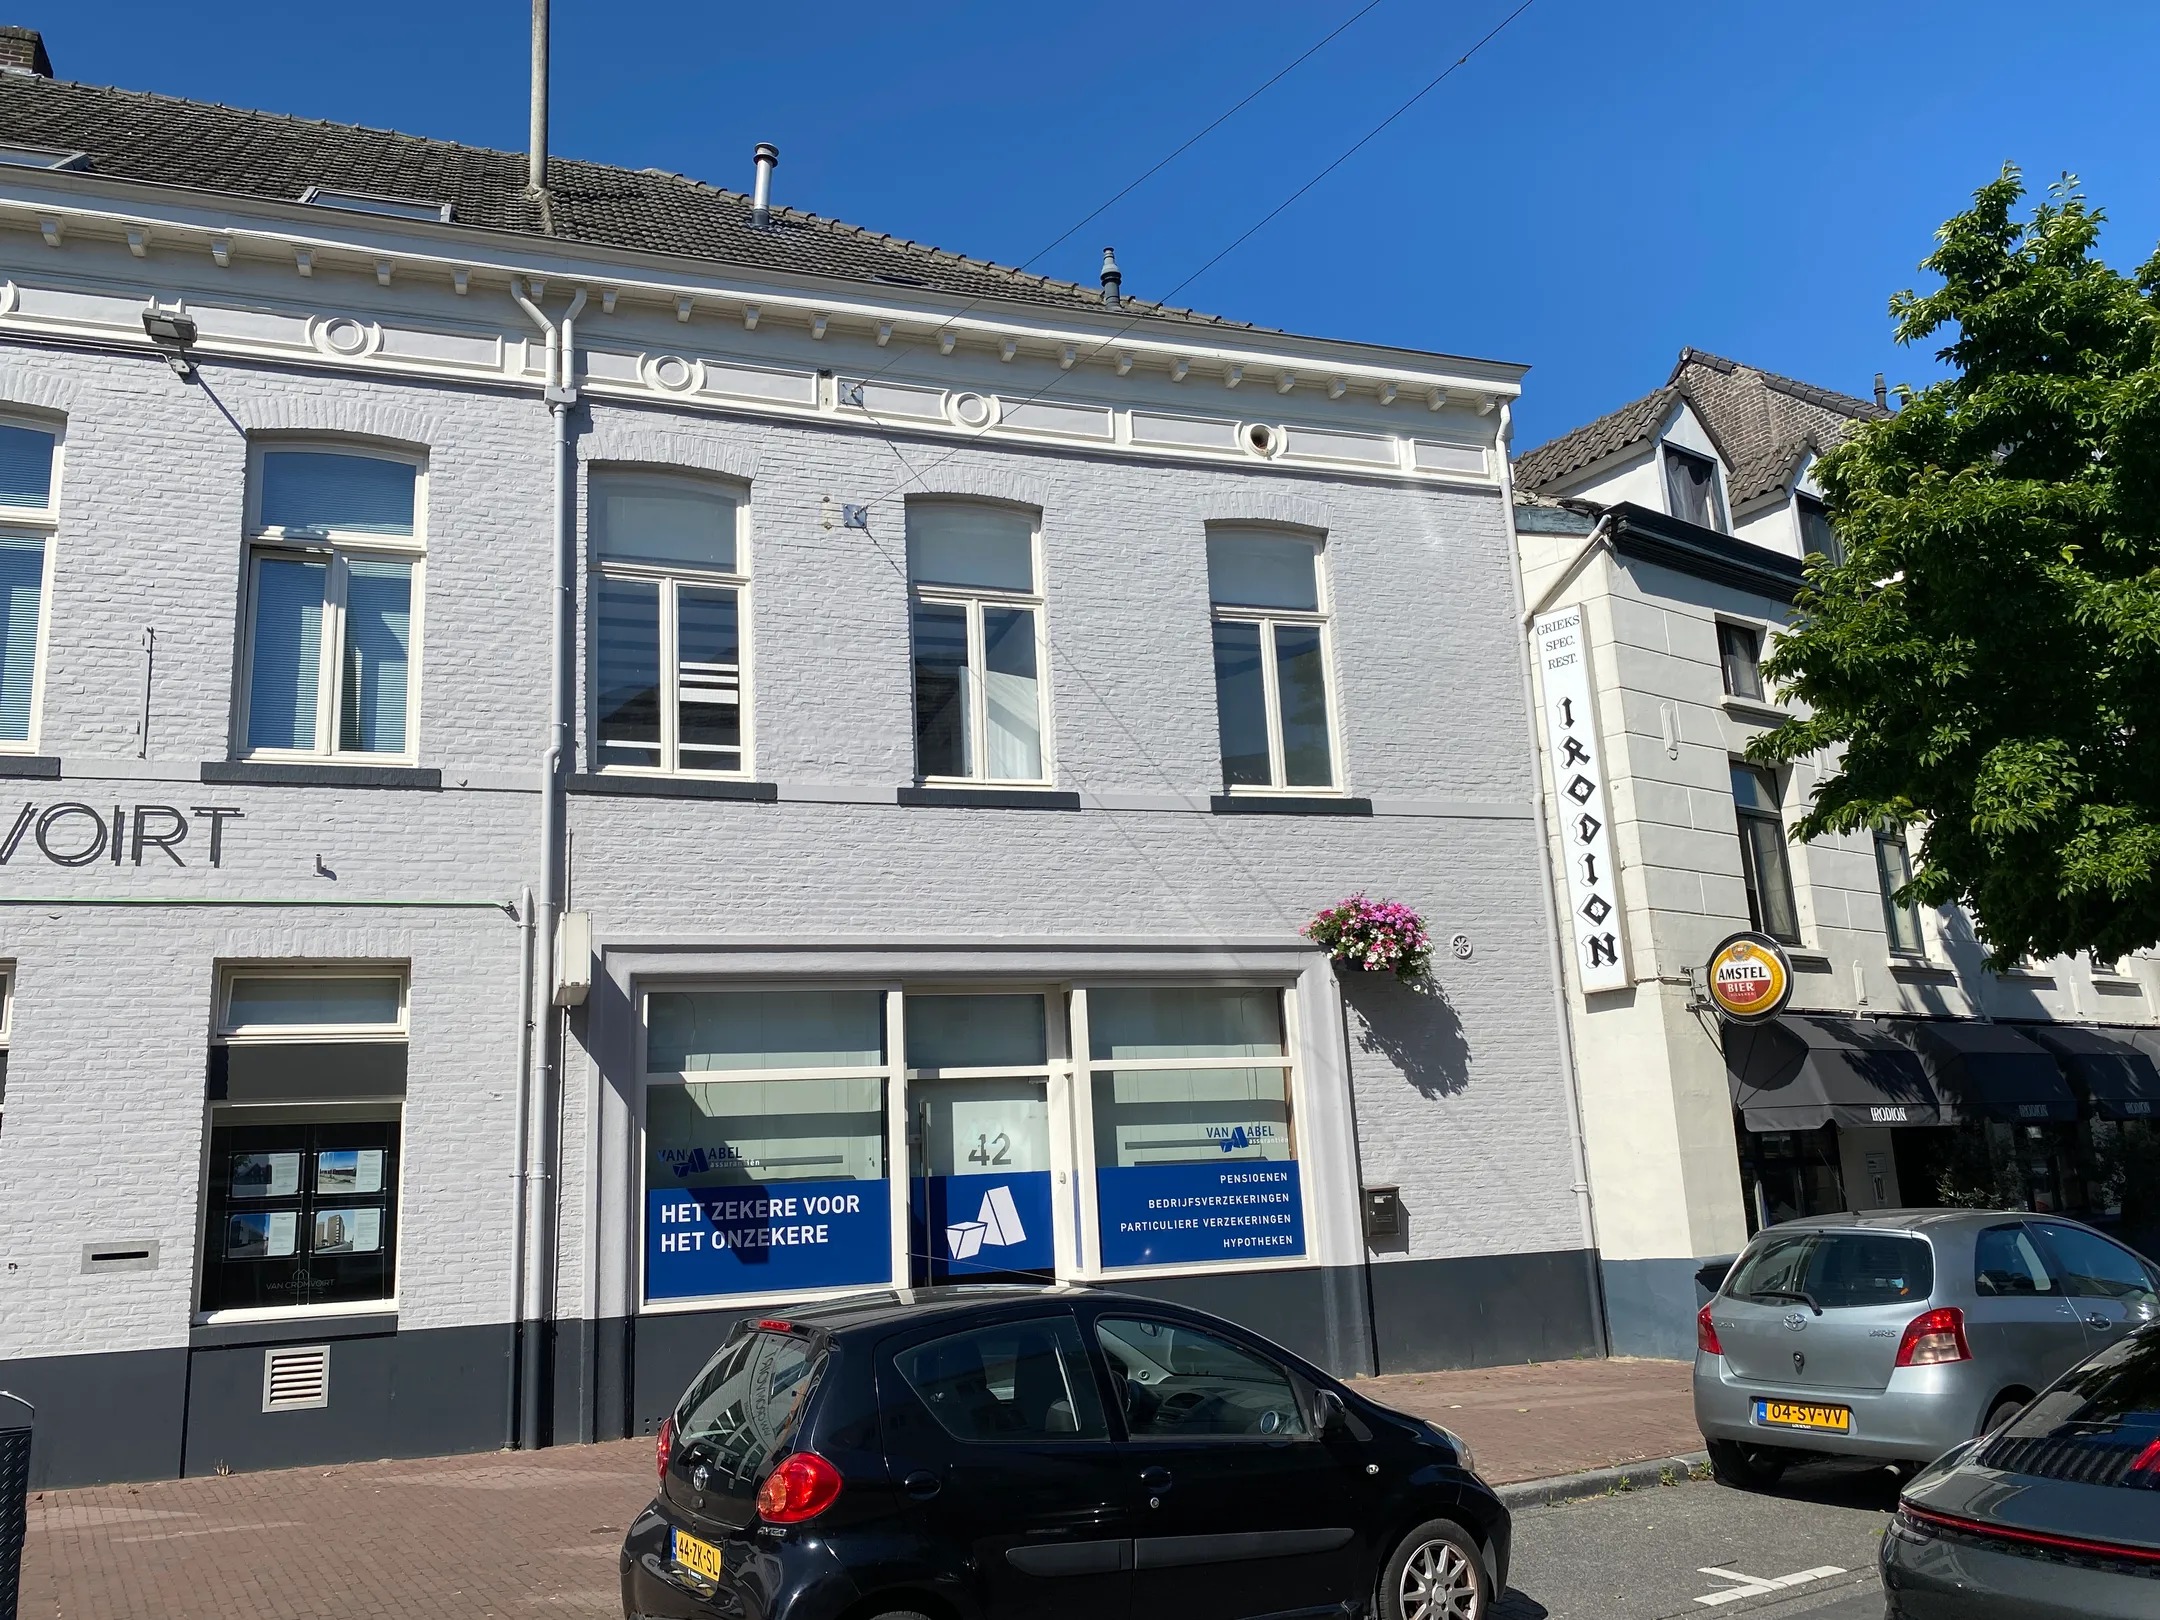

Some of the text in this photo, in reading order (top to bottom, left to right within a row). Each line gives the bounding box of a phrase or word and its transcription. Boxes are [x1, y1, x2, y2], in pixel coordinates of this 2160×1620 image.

[1536, 614, 1580, 636] GRIEKS
[1545, 635, 1575, 652] SPEC.
[1548, 653, 1578, 670] REST.
[1556, 696, 1619, 970] IRODION
[1718, 966, 1766, 981] AMSTEL
[1727, 982, 1755, 993] BIER
[1870, 1107, 1907, 1122] IRODION
[1206, 1125, 1275, 1138] VAN ABEL
[657, 1146, 742, 1163] VAN ABEL
[968, 1132, 1012, 1166] 42
[1220, 1172, 1288, 1184] PENSIOENEN
[661, 1195, 860, 1223] HET ZEKERE VOOR
[1148, 1193, 1290, 1209] BEDRIJFSVERZEKERINGEN
[1120, 1214, 1292, 1232] PARTICULIERE VERZEKERINGEN
[661, 1224, 829, 1252] HET ONZEKERE
[1223, 1235, 1293, 1248] HYPOTHEKEN
[266, 1282, 284, 1290] VAN
[1771, 1404, 1843, 1425] 04-SV-VV
[678, 1537, 719, 1577] 44-ZK-SL
